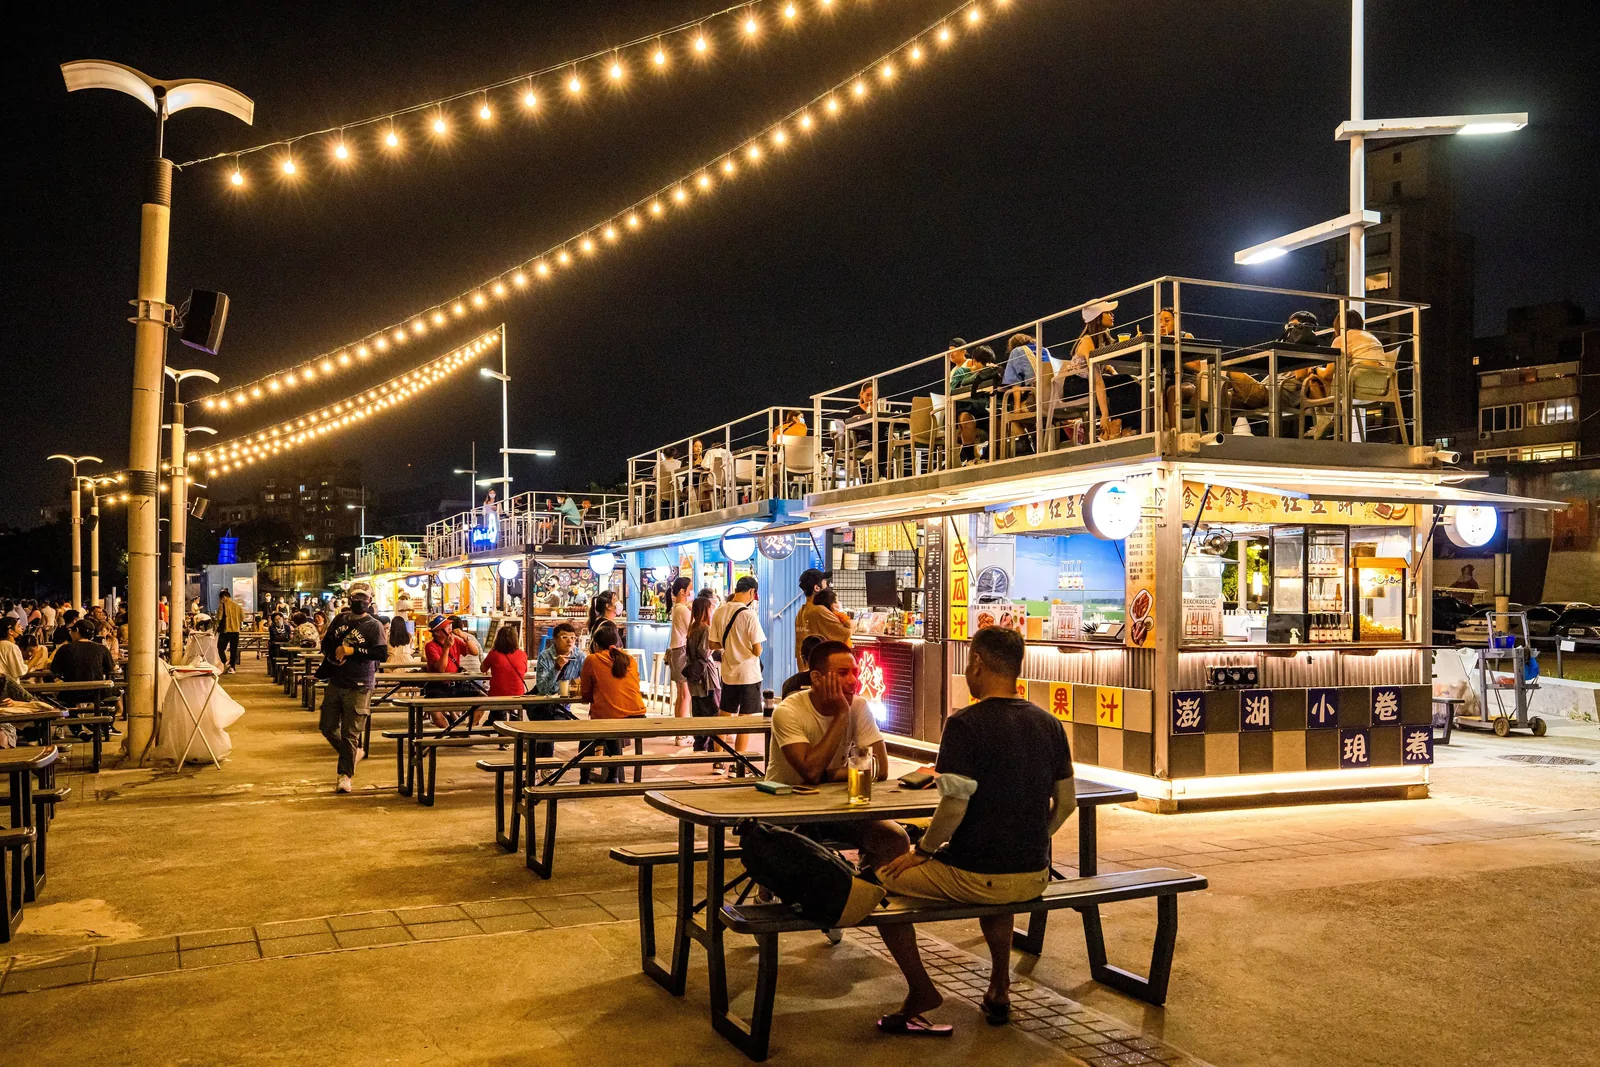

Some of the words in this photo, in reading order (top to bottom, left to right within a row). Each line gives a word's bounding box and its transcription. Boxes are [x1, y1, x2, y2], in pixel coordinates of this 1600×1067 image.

[1048, 494, 1084, 520] 紅豆
[1182, 486, 1253, 512] 食全食美
[953, 542, 966, 637] 西瓜汁
[1176, 691, 1399, 727] 澎湖小卷
[1343, 730, 1431, 764] 現煮
